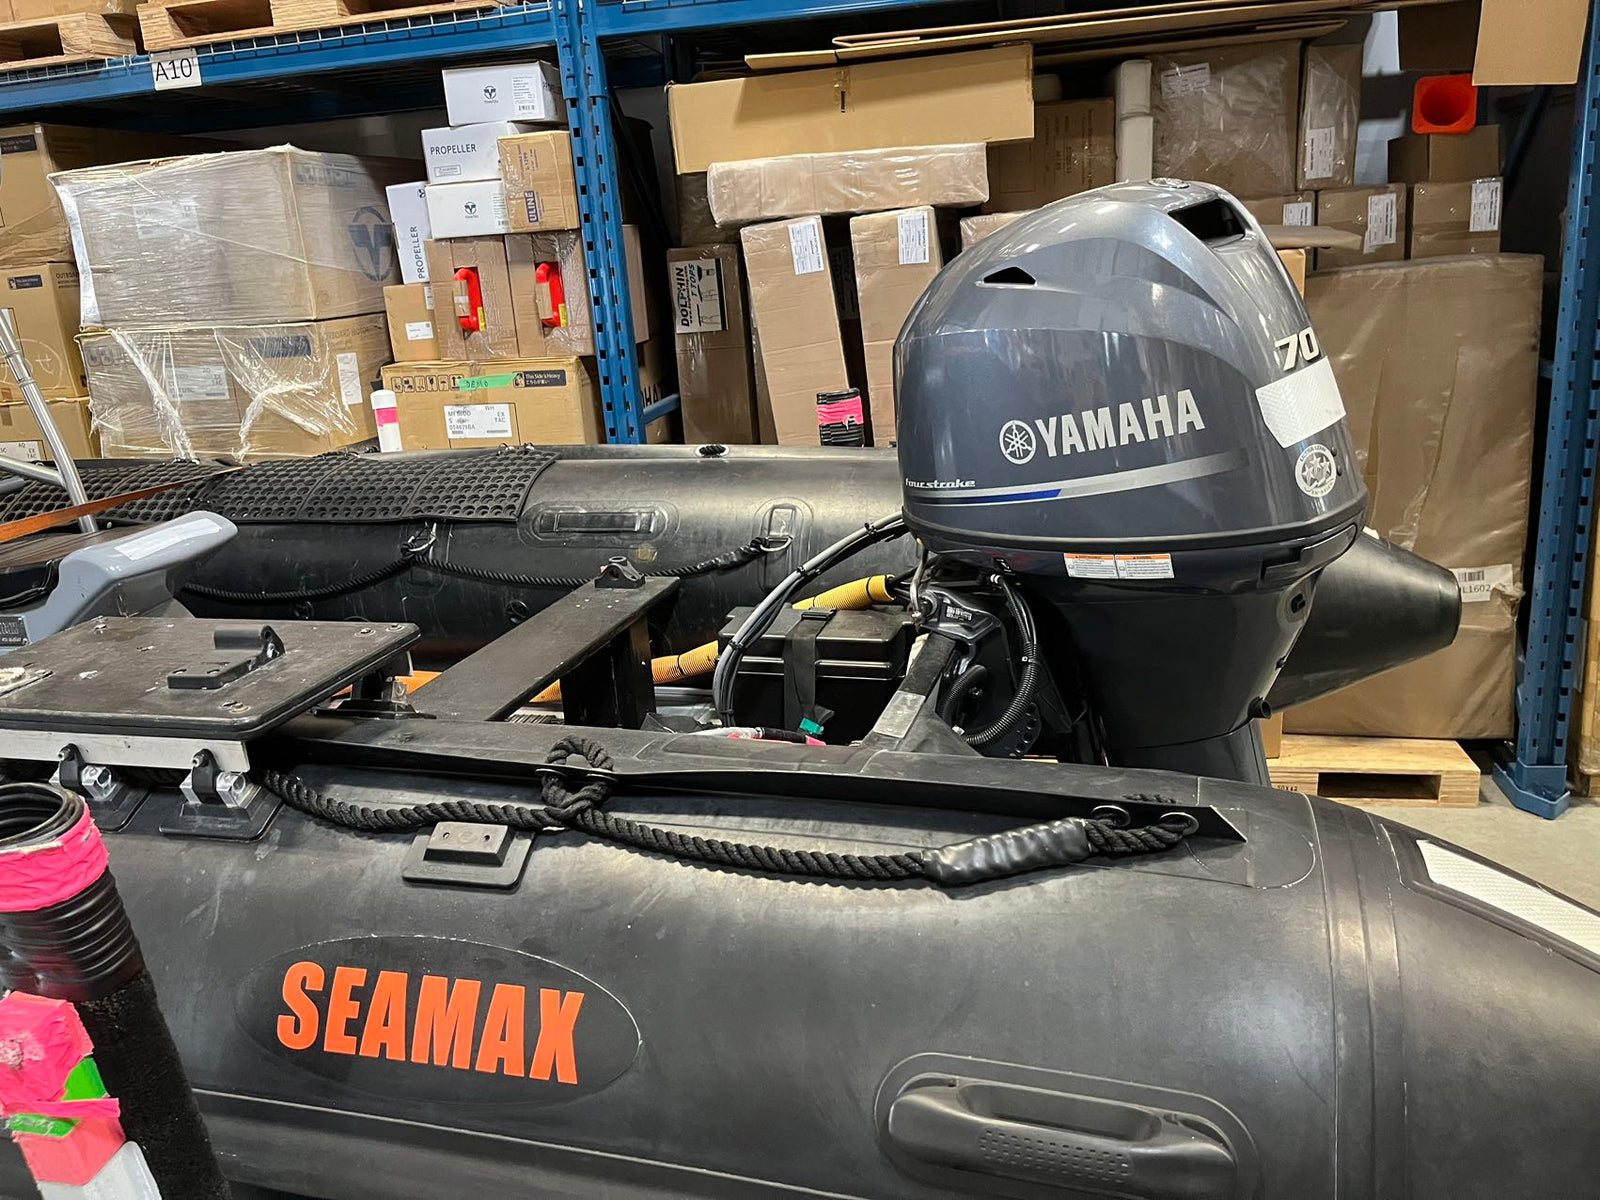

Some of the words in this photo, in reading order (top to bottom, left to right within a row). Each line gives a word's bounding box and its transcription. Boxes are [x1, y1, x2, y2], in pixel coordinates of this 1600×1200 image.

[156, 58, 193, 82] A10
[430, 144, 477, 156] PROPELLER
[525, 191, 538, 222] ULINE
[410, 226, 426, 279] PROPELLER
[675, 267, 690, 327] DOLPHIN
[688, 263, 697, 289] TOPS
[1274, 326, 1320, 371] 70
[1034, 388, 1206, 458] YAMAHA
[276, 961, 585, 1085] SEAMAX
